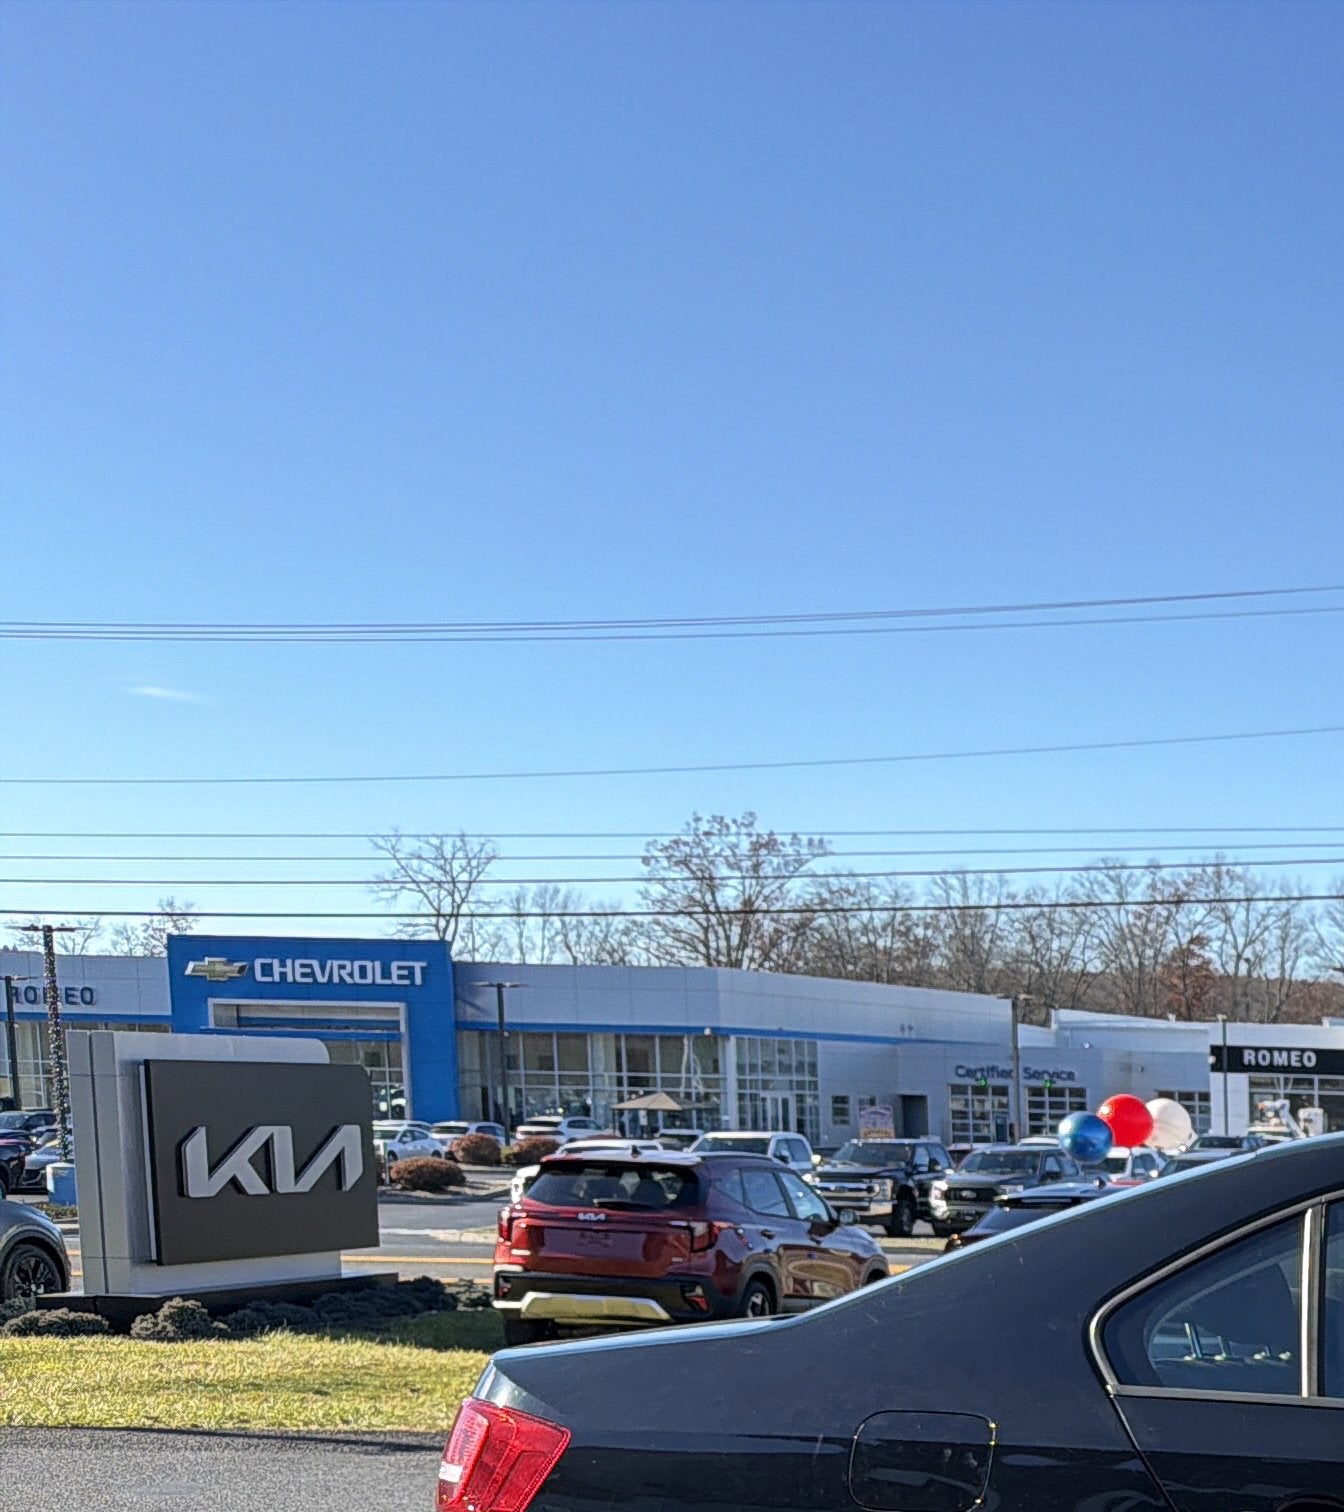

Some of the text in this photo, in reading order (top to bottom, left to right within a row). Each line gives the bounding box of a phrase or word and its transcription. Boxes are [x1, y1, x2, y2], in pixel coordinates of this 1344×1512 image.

[254, 957, 428, 986] CHEVROLET
[11, 985, 95, 1005] ROEO
[1242, 1048, 1317, 1068] ROMEO
[1023, 1066, 1076, 1080] Service
[180, 1124, 364, 1198] KIA
